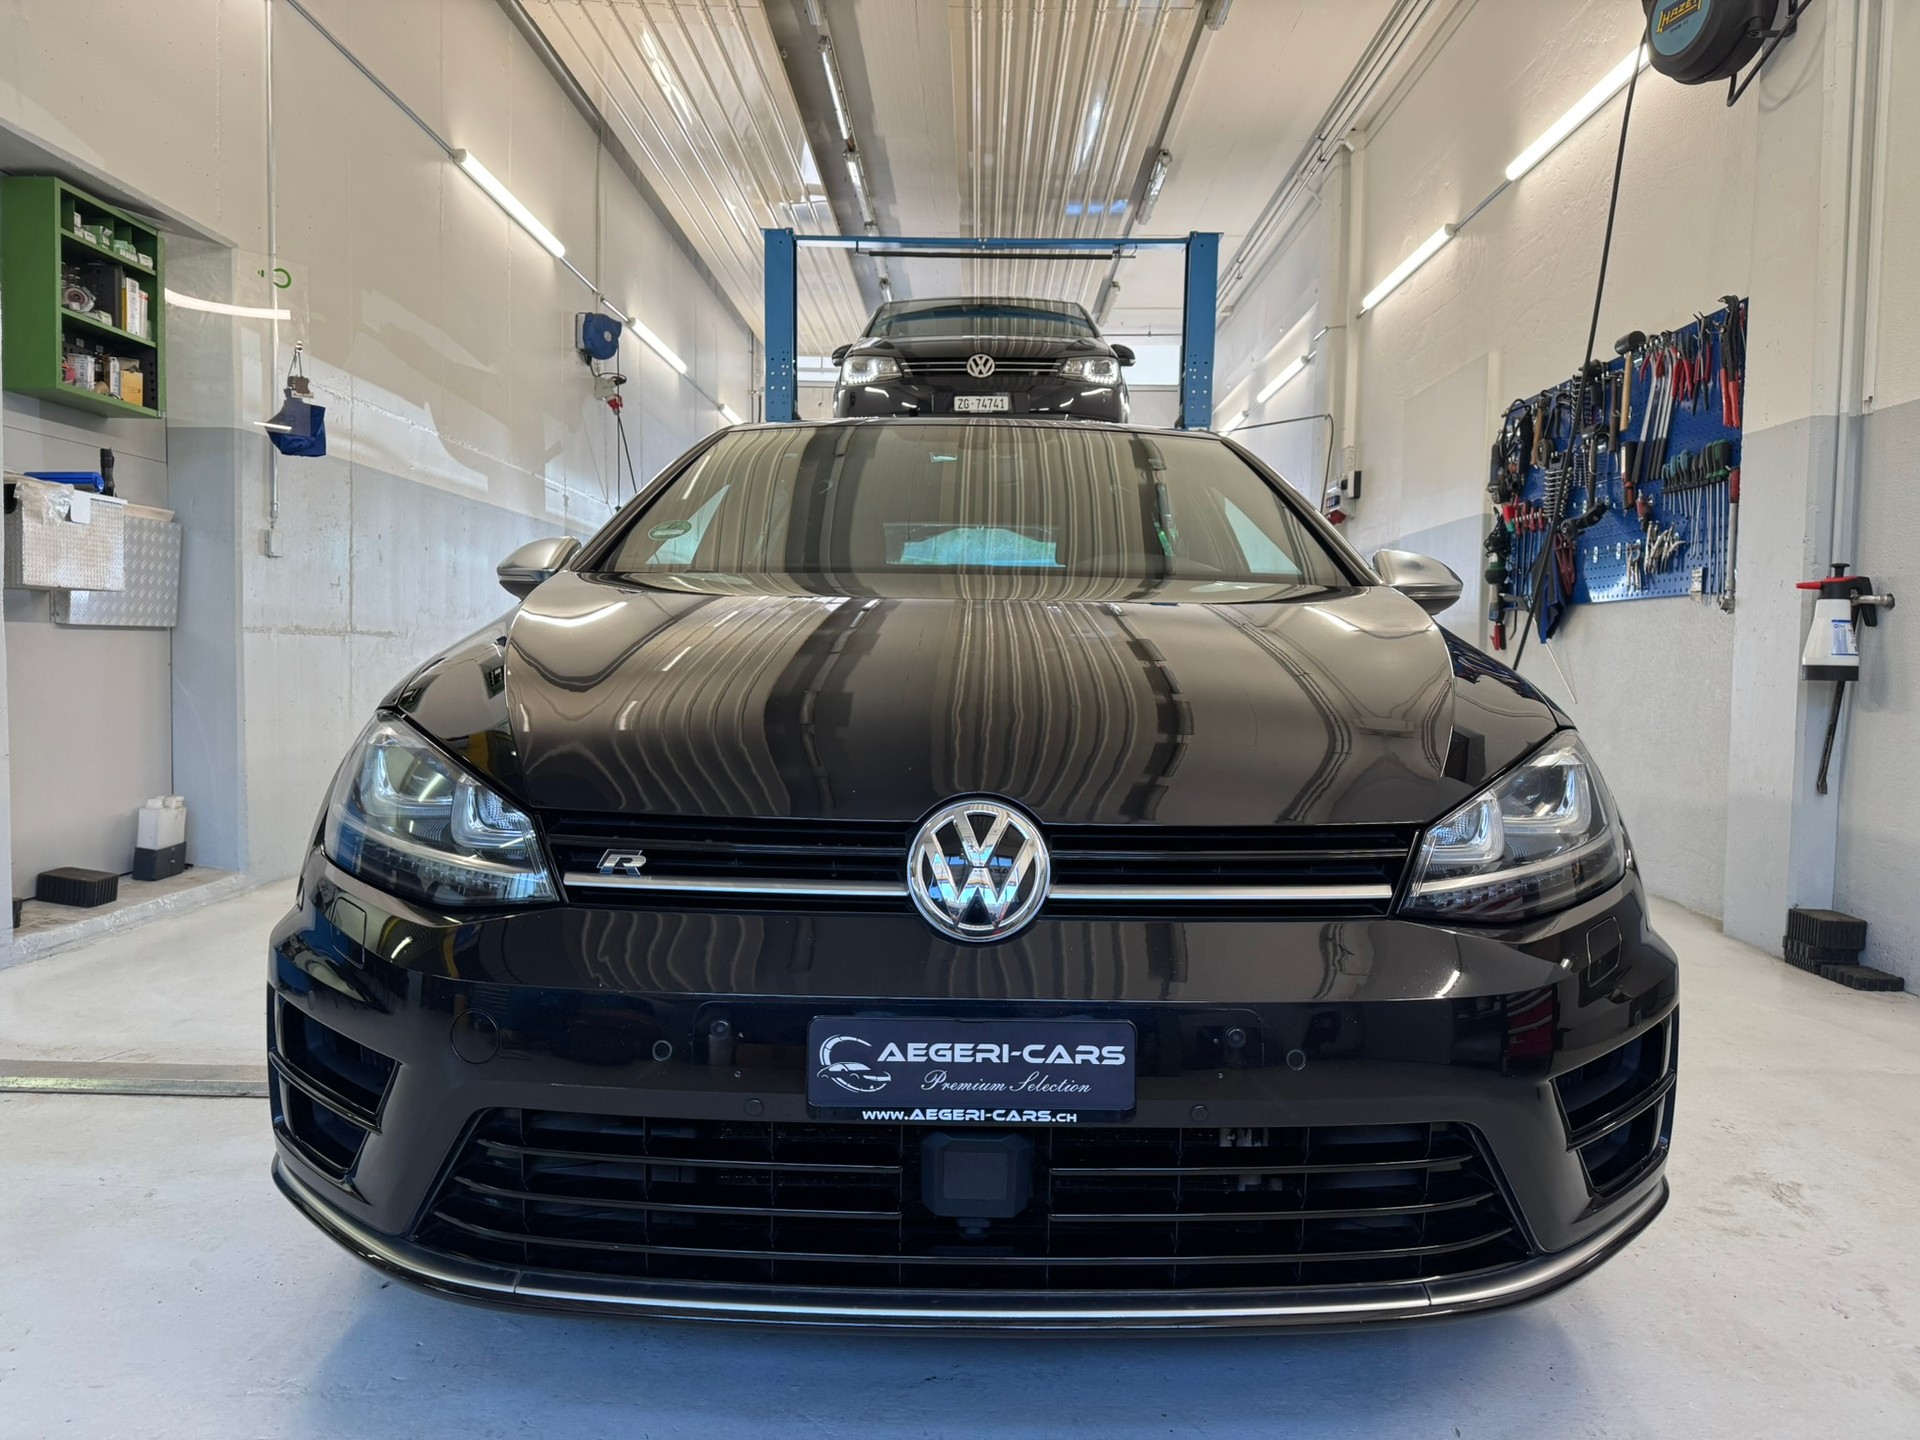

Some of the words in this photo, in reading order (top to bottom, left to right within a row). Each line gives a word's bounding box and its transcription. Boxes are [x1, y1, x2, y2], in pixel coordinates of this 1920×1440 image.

[911, 803, 1046, 938] VW
[877, 1042, 1126, 1066] AEGERI-CARS
[920, 1069, 1007, 1092] Premium
[1009, 1071, 1092, 1093] Selection
